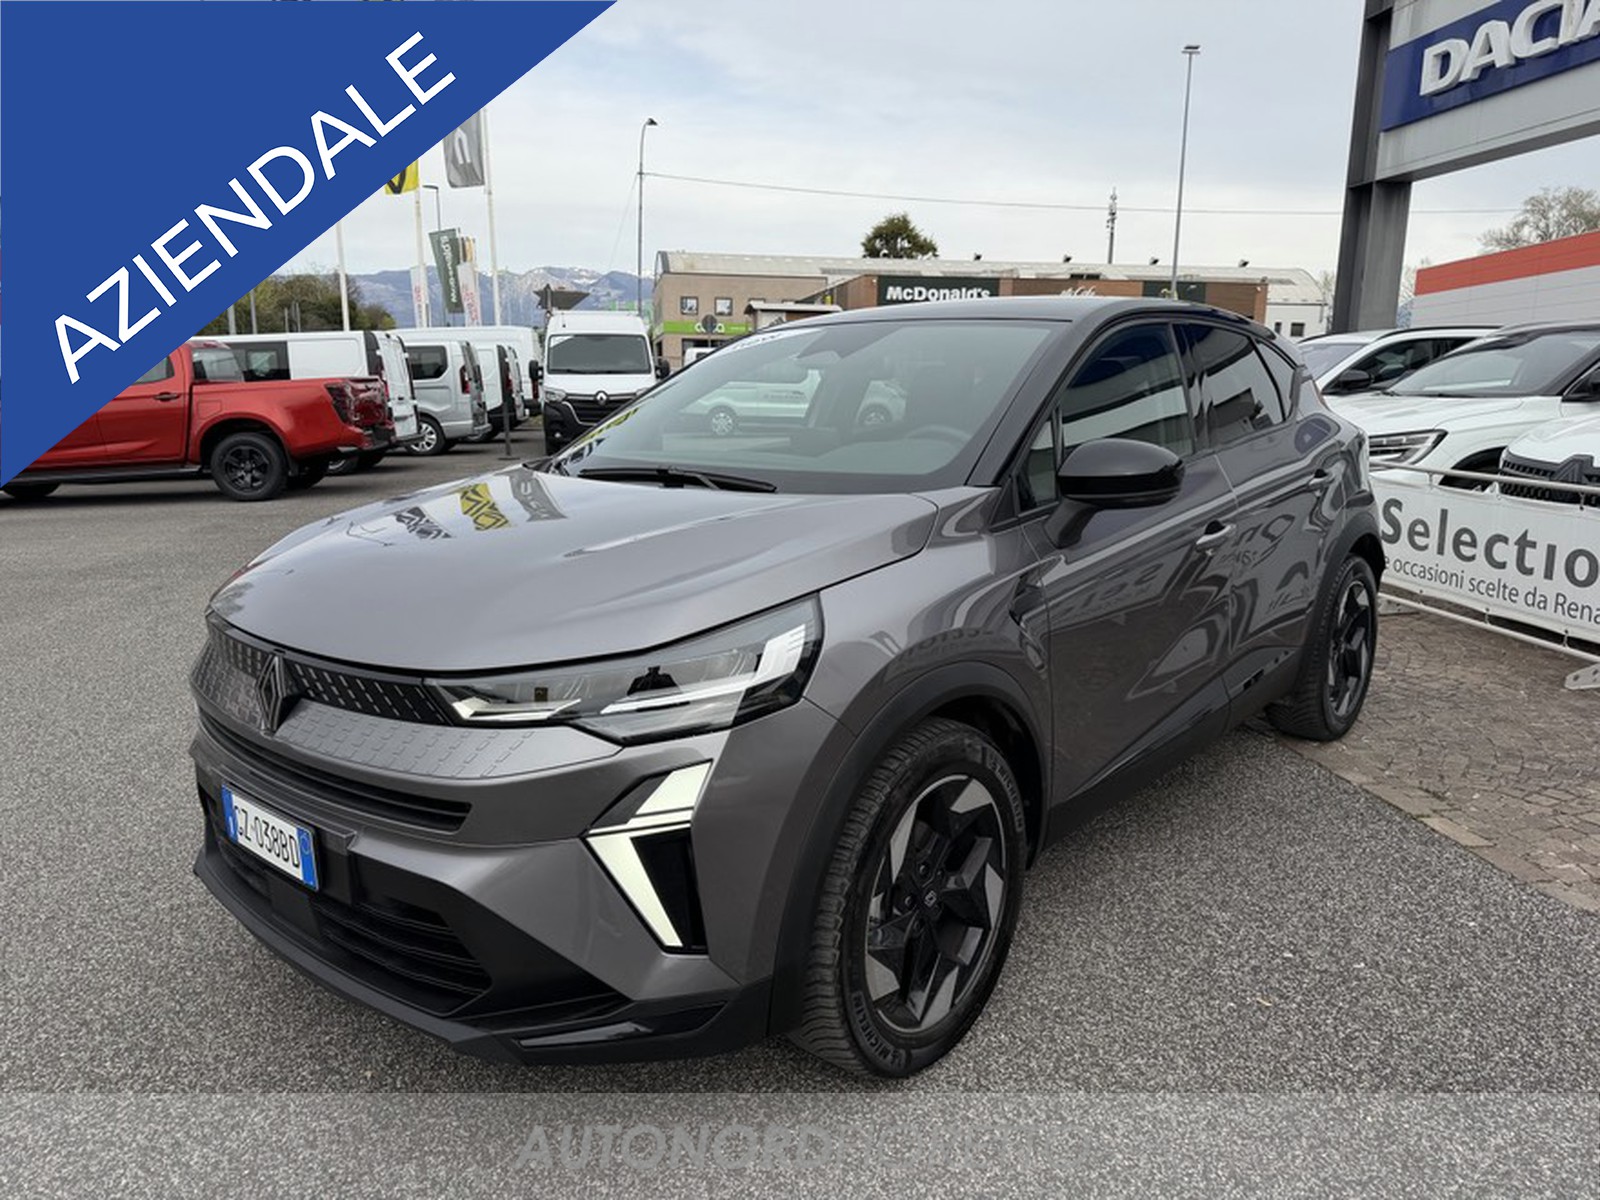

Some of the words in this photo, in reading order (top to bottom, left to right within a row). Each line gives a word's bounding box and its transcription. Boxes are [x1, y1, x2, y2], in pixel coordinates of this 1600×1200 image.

[886, 286, 991, 301] McDonald's
[1393, 558, 1465, 590] occasioni
[1468, 577, 1519, 604] scelte
[1524, 586, 1548, 612] da
